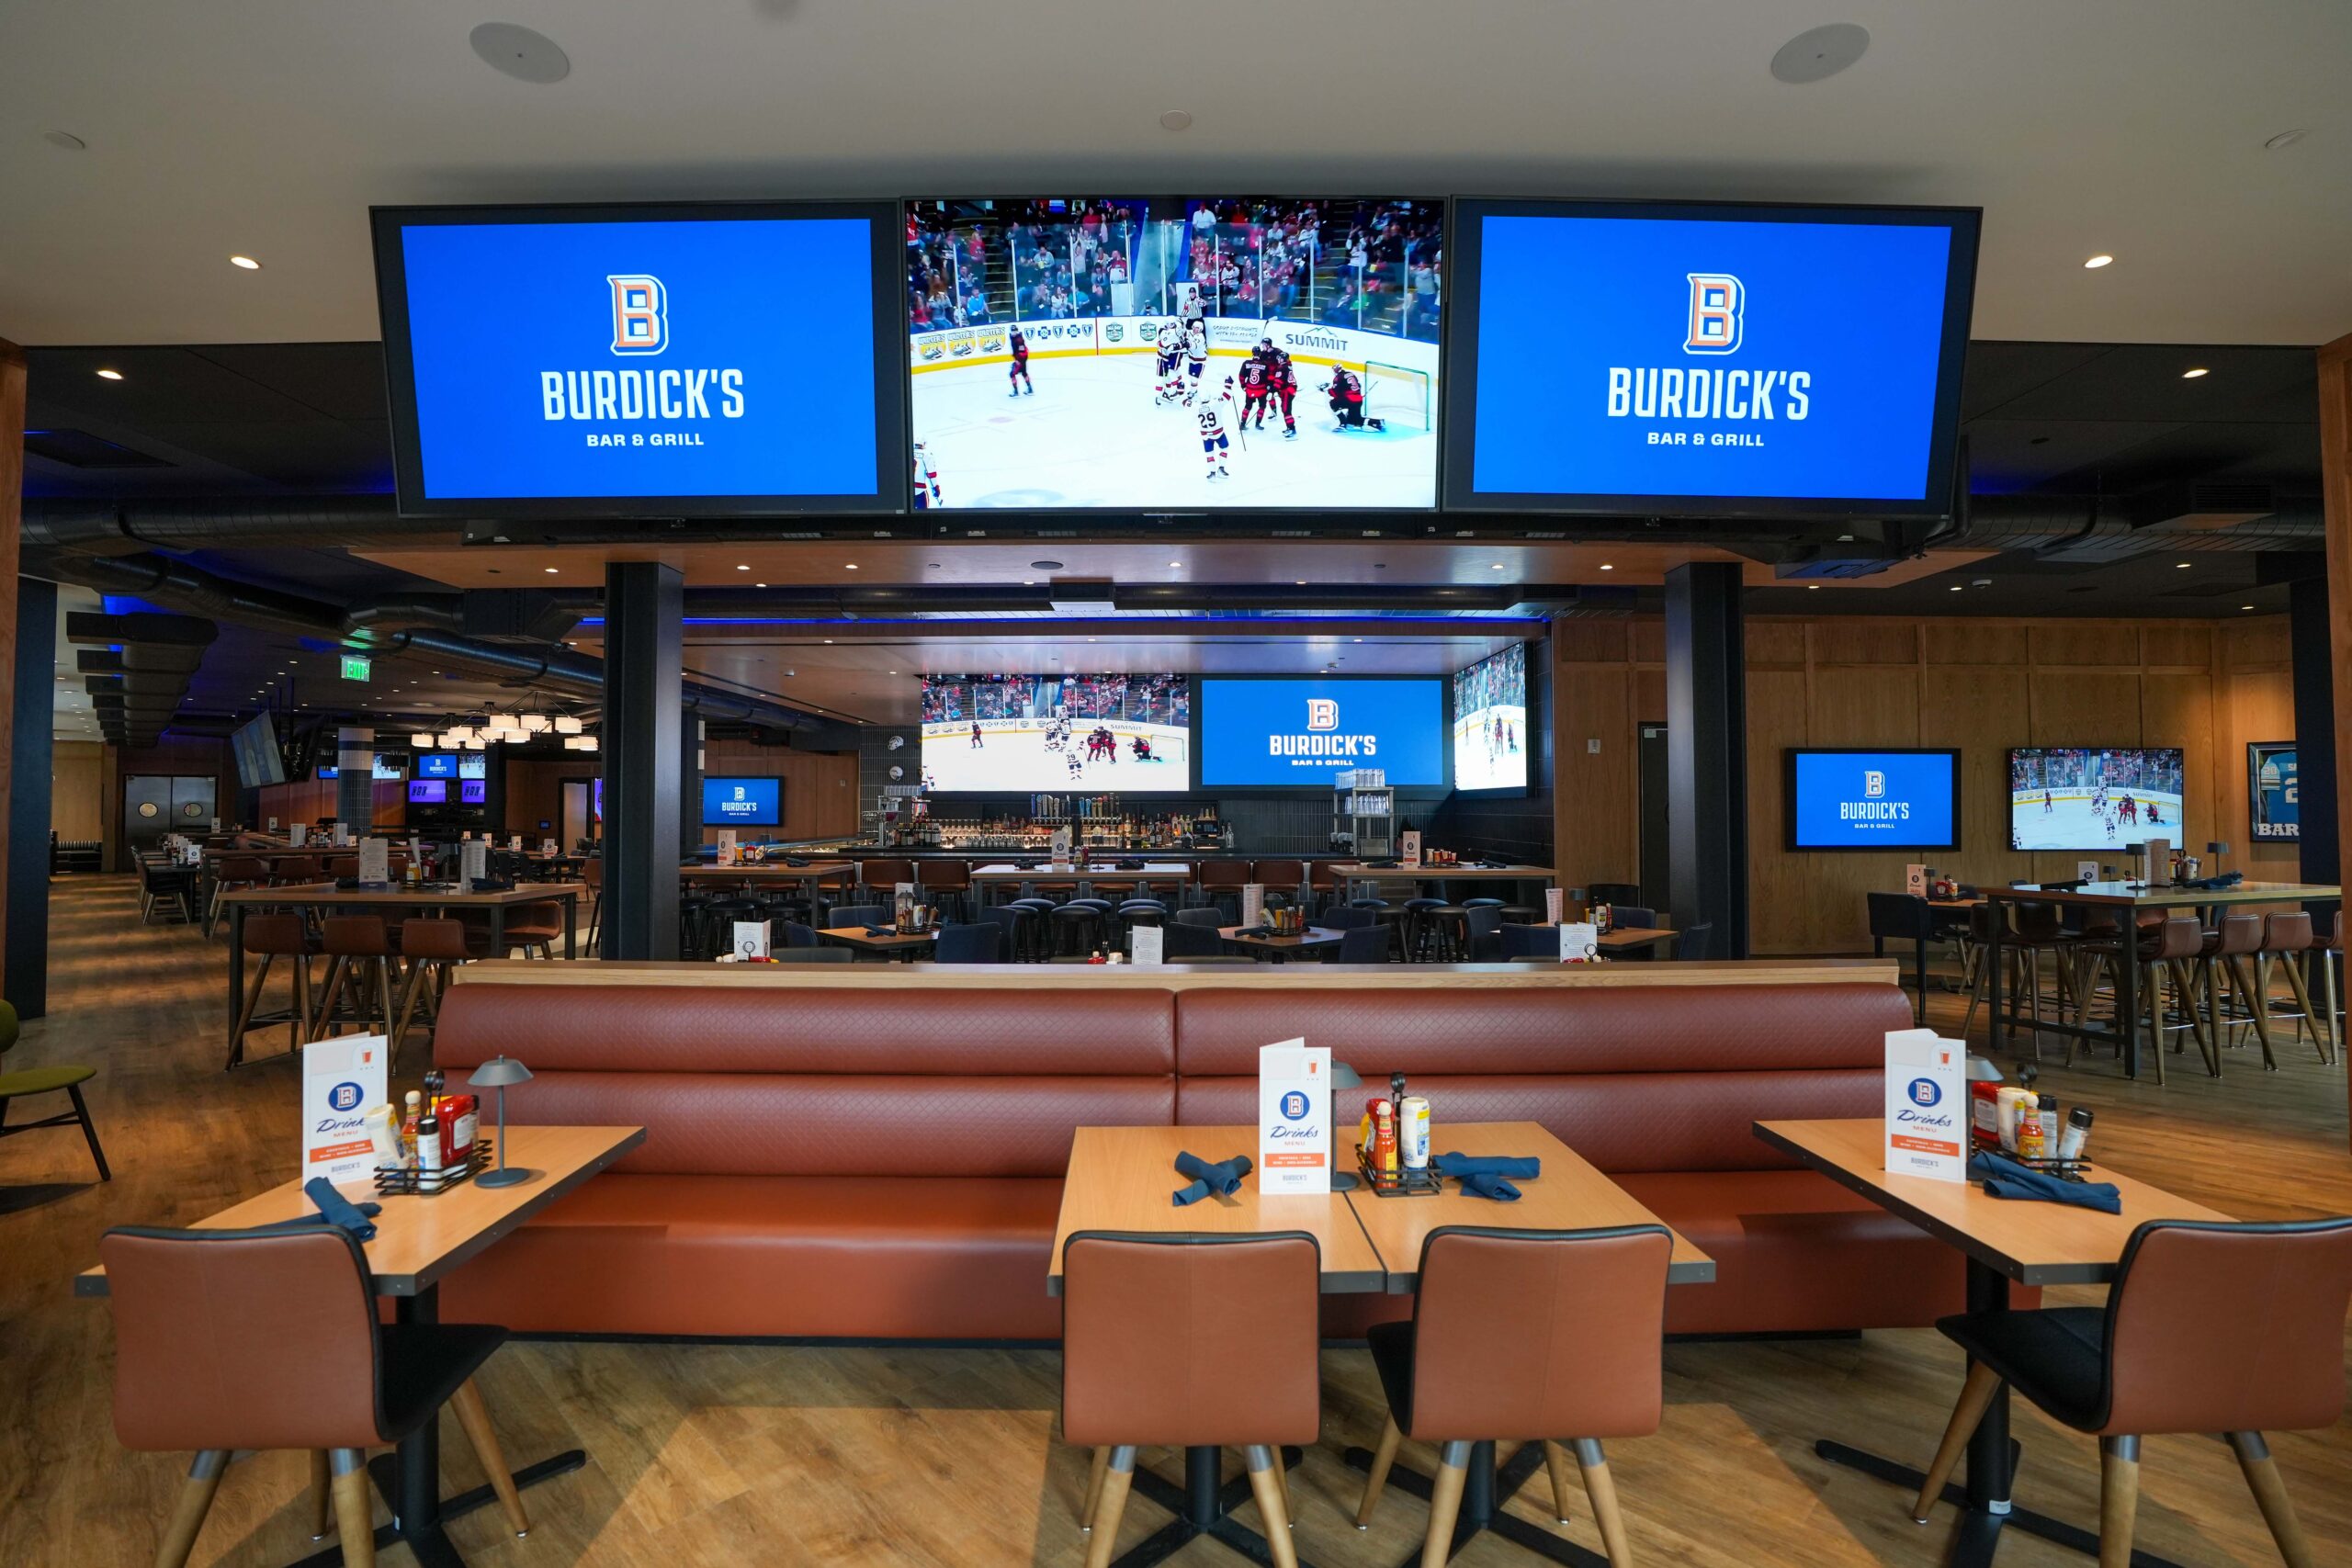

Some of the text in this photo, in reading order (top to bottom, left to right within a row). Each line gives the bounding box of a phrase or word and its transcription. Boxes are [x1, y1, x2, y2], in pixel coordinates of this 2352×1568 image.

[607, 274, 669, 356] B
[1682, 273, 1746, 355] B
[1285, 333, 1349, 352] SUMMIT
[1249, 368, 1260, 385] 5
[540, 368, 744, 421] BURDICK'S
[1607, 367, 1811, 421] BURDICK'S
[1197, 412, 1217, 429] 29
[586, 434, 705, 446] BAR & GRILL
[1647, 433, 1765, 446] BAR & GRILL
[346, 660, 366, 679] EXIT
[1306, 699, 1339, 731] B
[1269, 735, 1376, 756] BURDICK'S
[2264, 766, 2278, 775] 20
[1864, 771, 1885, 798] B
[721, 802, 757, 812] BURDICK'S
[1840, 802, 1909, 819] BURDICK'S
[336, 1086, 356, 1109] B
[1916, 1081, 1935, 1104] B
[1286, 1095, 1305, 1117] B
[1896, 1109, 1952, 1127] Drinks
[1270, 1125, 1319, 1139] Drinks
